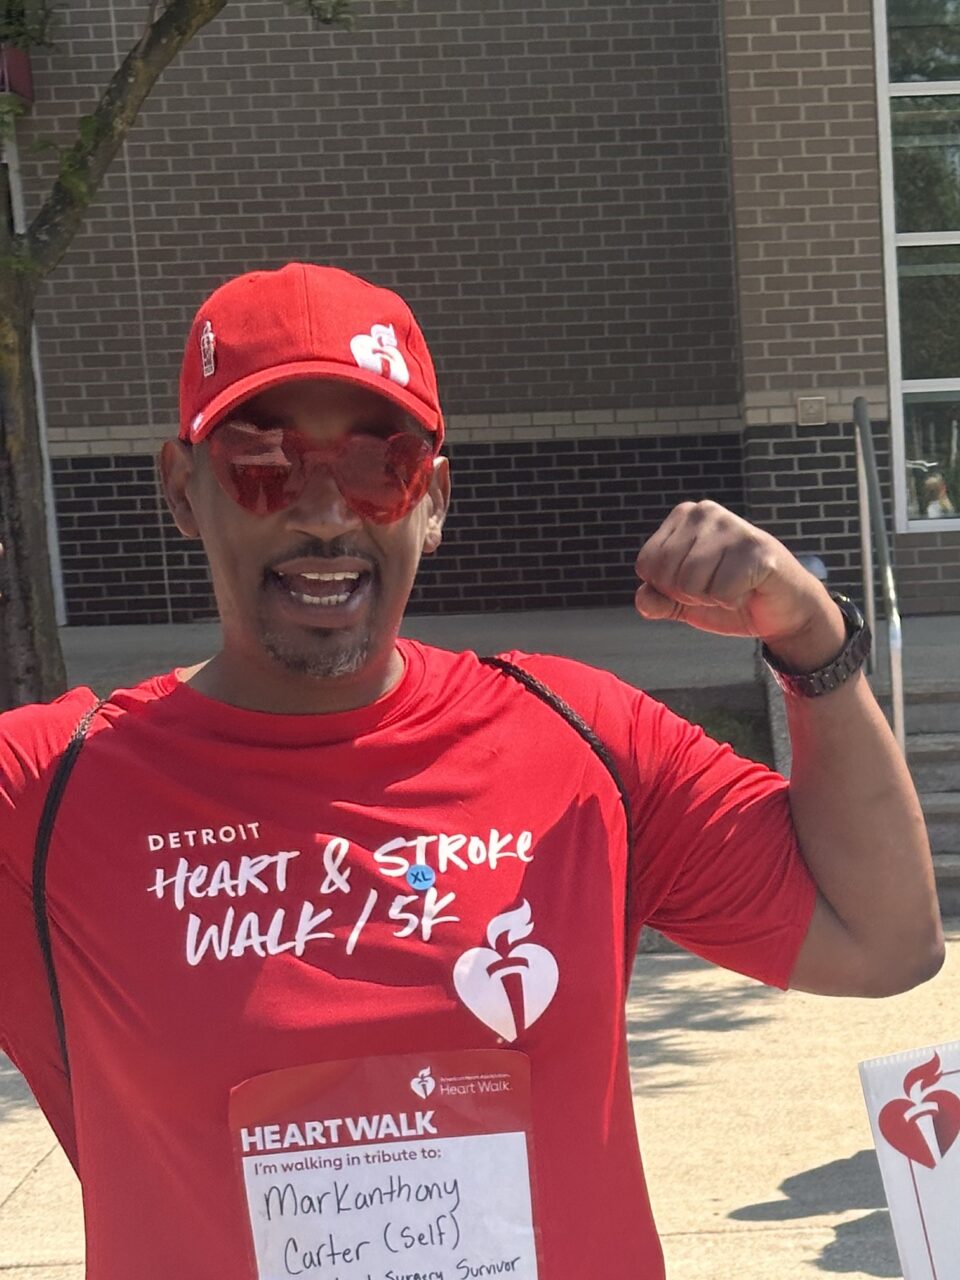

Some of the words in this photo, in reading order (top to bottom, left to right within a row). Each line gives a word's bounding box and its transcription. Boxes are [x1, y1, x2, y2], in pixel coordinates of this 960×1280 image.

[148, 822, 261, 852] DETROIT
[319, 837, 351, 895] &
[410, 870, 432, 885] XL
[186, 900, 335, 966] WALK
[389, 887, 460, 941] 5K
[440, 1083, 476, 1096] Heart
[240, 1118, 343, 1152] HEART
[344, 1110, 438, 1142] WALK
[254, 1162, 278, 1176] I'm
[281, 1155, 343, 1172] walking
[346, 1153, 361, 1166] in
[364, 1149, 418, 1164] tribute
[421, 1147, 442, 1160] to:
[283, 1233, 371, 1276] Carter
[455, 1256, 522, 1280] Survivor
